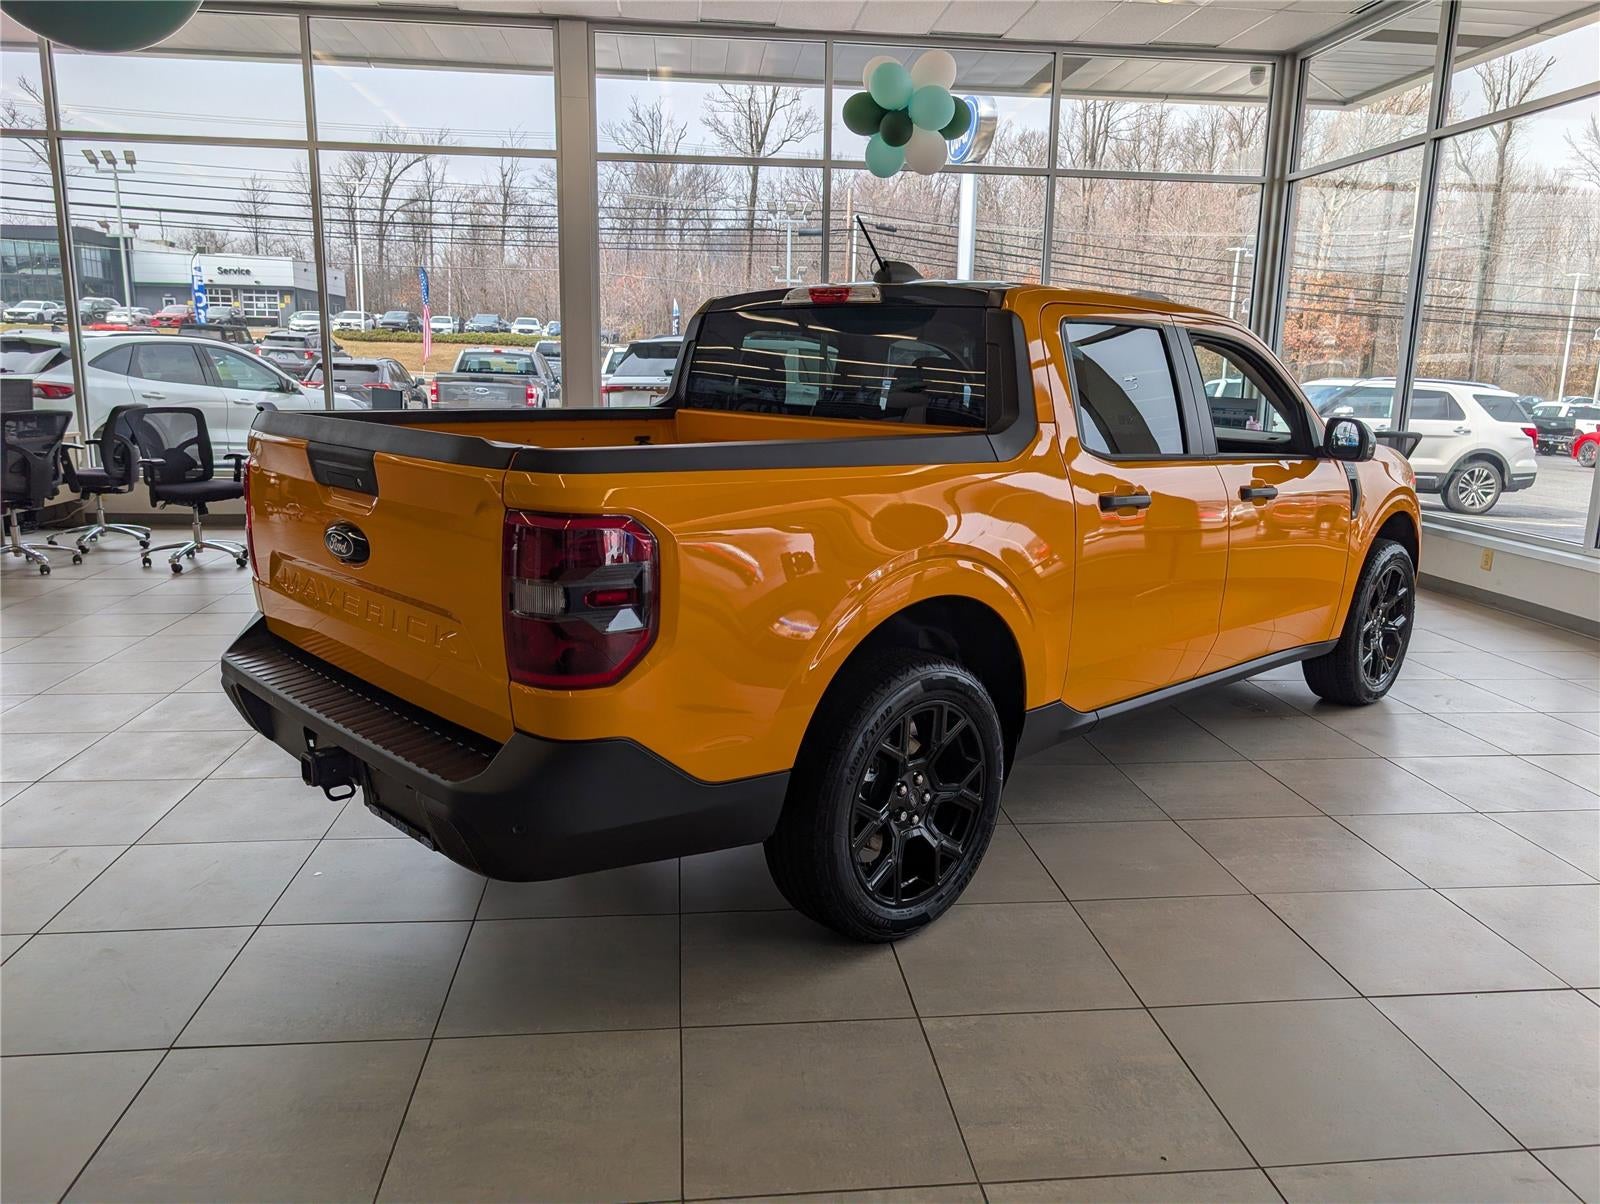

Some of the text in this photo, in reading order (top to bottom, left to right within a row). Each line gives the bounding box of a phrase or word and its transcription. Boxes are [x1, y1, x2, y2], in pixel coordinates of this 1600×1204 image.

[217, 266, 251, 276] Service
[328, 533, 348, 553] Ford
[279, 566, 458, 655] MAVERICK
